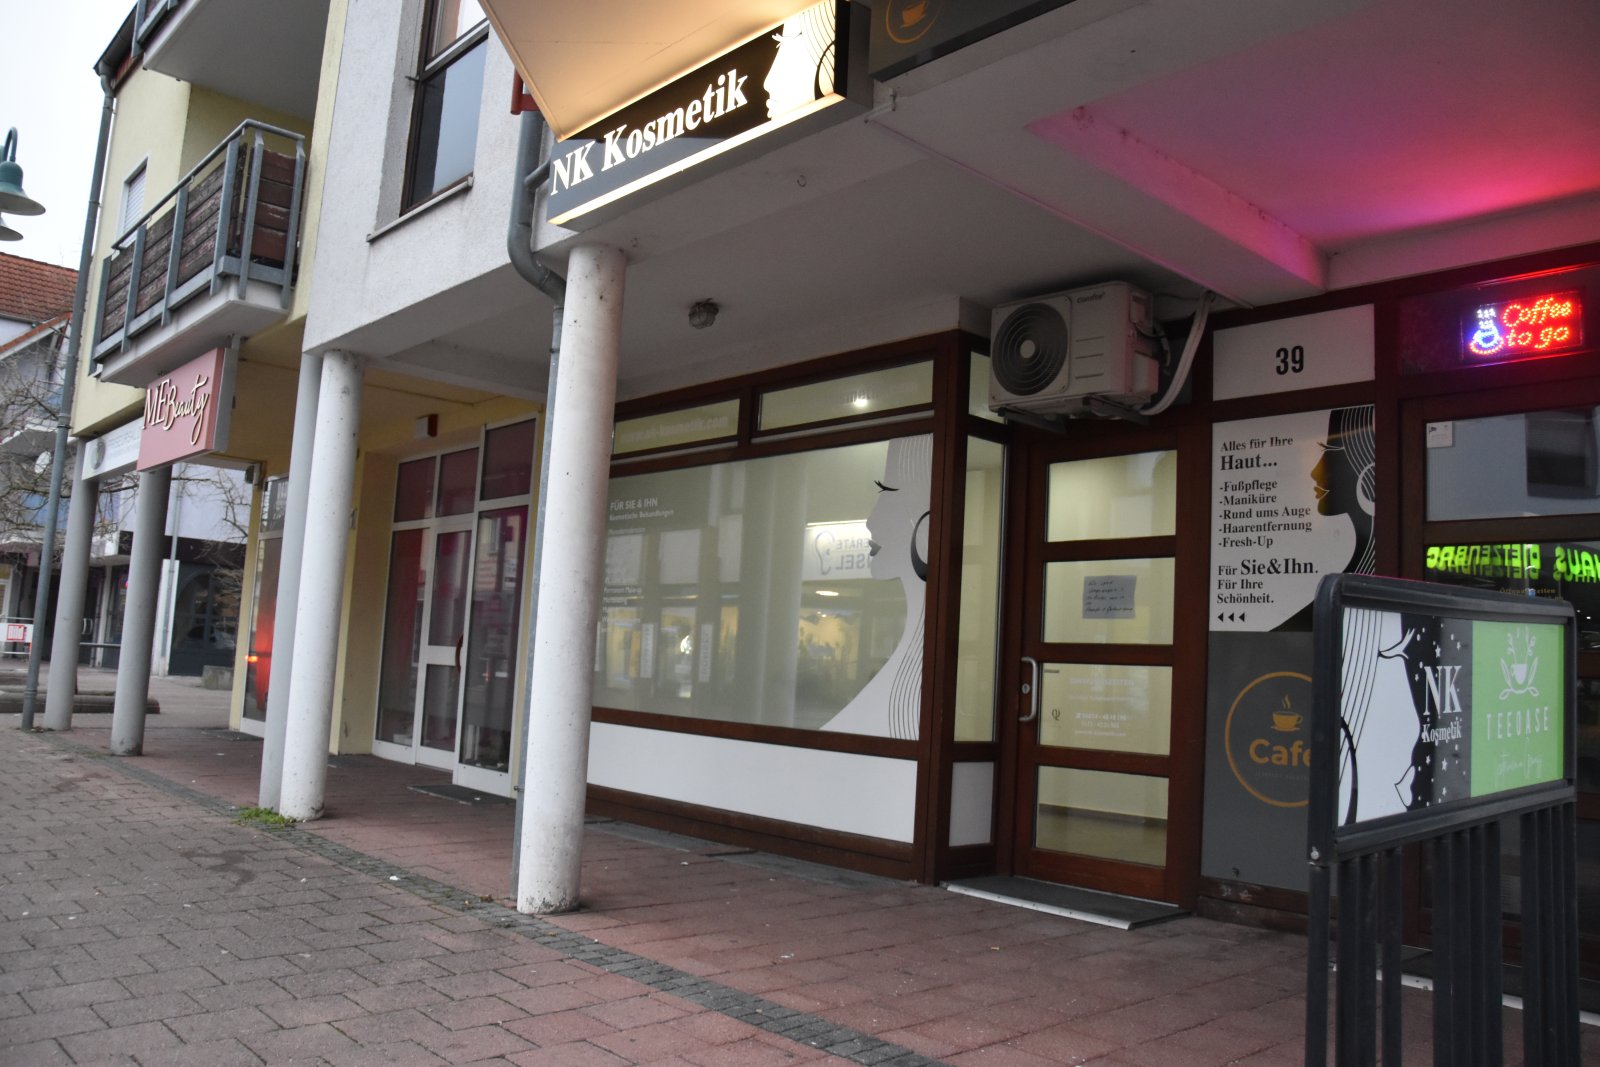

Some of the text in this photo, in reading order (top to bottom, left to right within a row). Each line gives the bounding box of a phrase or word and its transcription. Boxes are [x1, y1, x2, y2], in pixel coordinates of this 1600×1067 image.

[550, 69, 748, 196] NK Kosmetik
[1502, 297, 1573, 328] Coffee
[1506, 326, 1570, 349] to go
[1275, 345, 1304, 375] 39
[1220, 436, 1294, 452] Alles für Ihre
[1220, 455, 1278, 471] Haut...
[1219, 480, 1278, 493] -Fußpflege
[609, 500, 624, 511] FÜR
[625, 499, 636, 510] SIE
[643, 497, 658, 508] IHN
[1219, 494, 1277, 506] -Maniküre
[1218, 506, 1311, 520] -Rund ums Auge
[1218, 520, 1313, 534] -Haarentfernung
[1218, 535, 1274, 548] -Fresh-Up
[1218, 558, 1318, 576] Für Sie&Ihn.
[1217, 579, 1264, 590] Für Ihre
[1217, 593, 1275, 604] Schönheit.
[1423, 665, 1462, 718] NK
[1422, 717, 1462, 743] Kosmetik
[1486, 706, 1549, 741] TEEOASE
